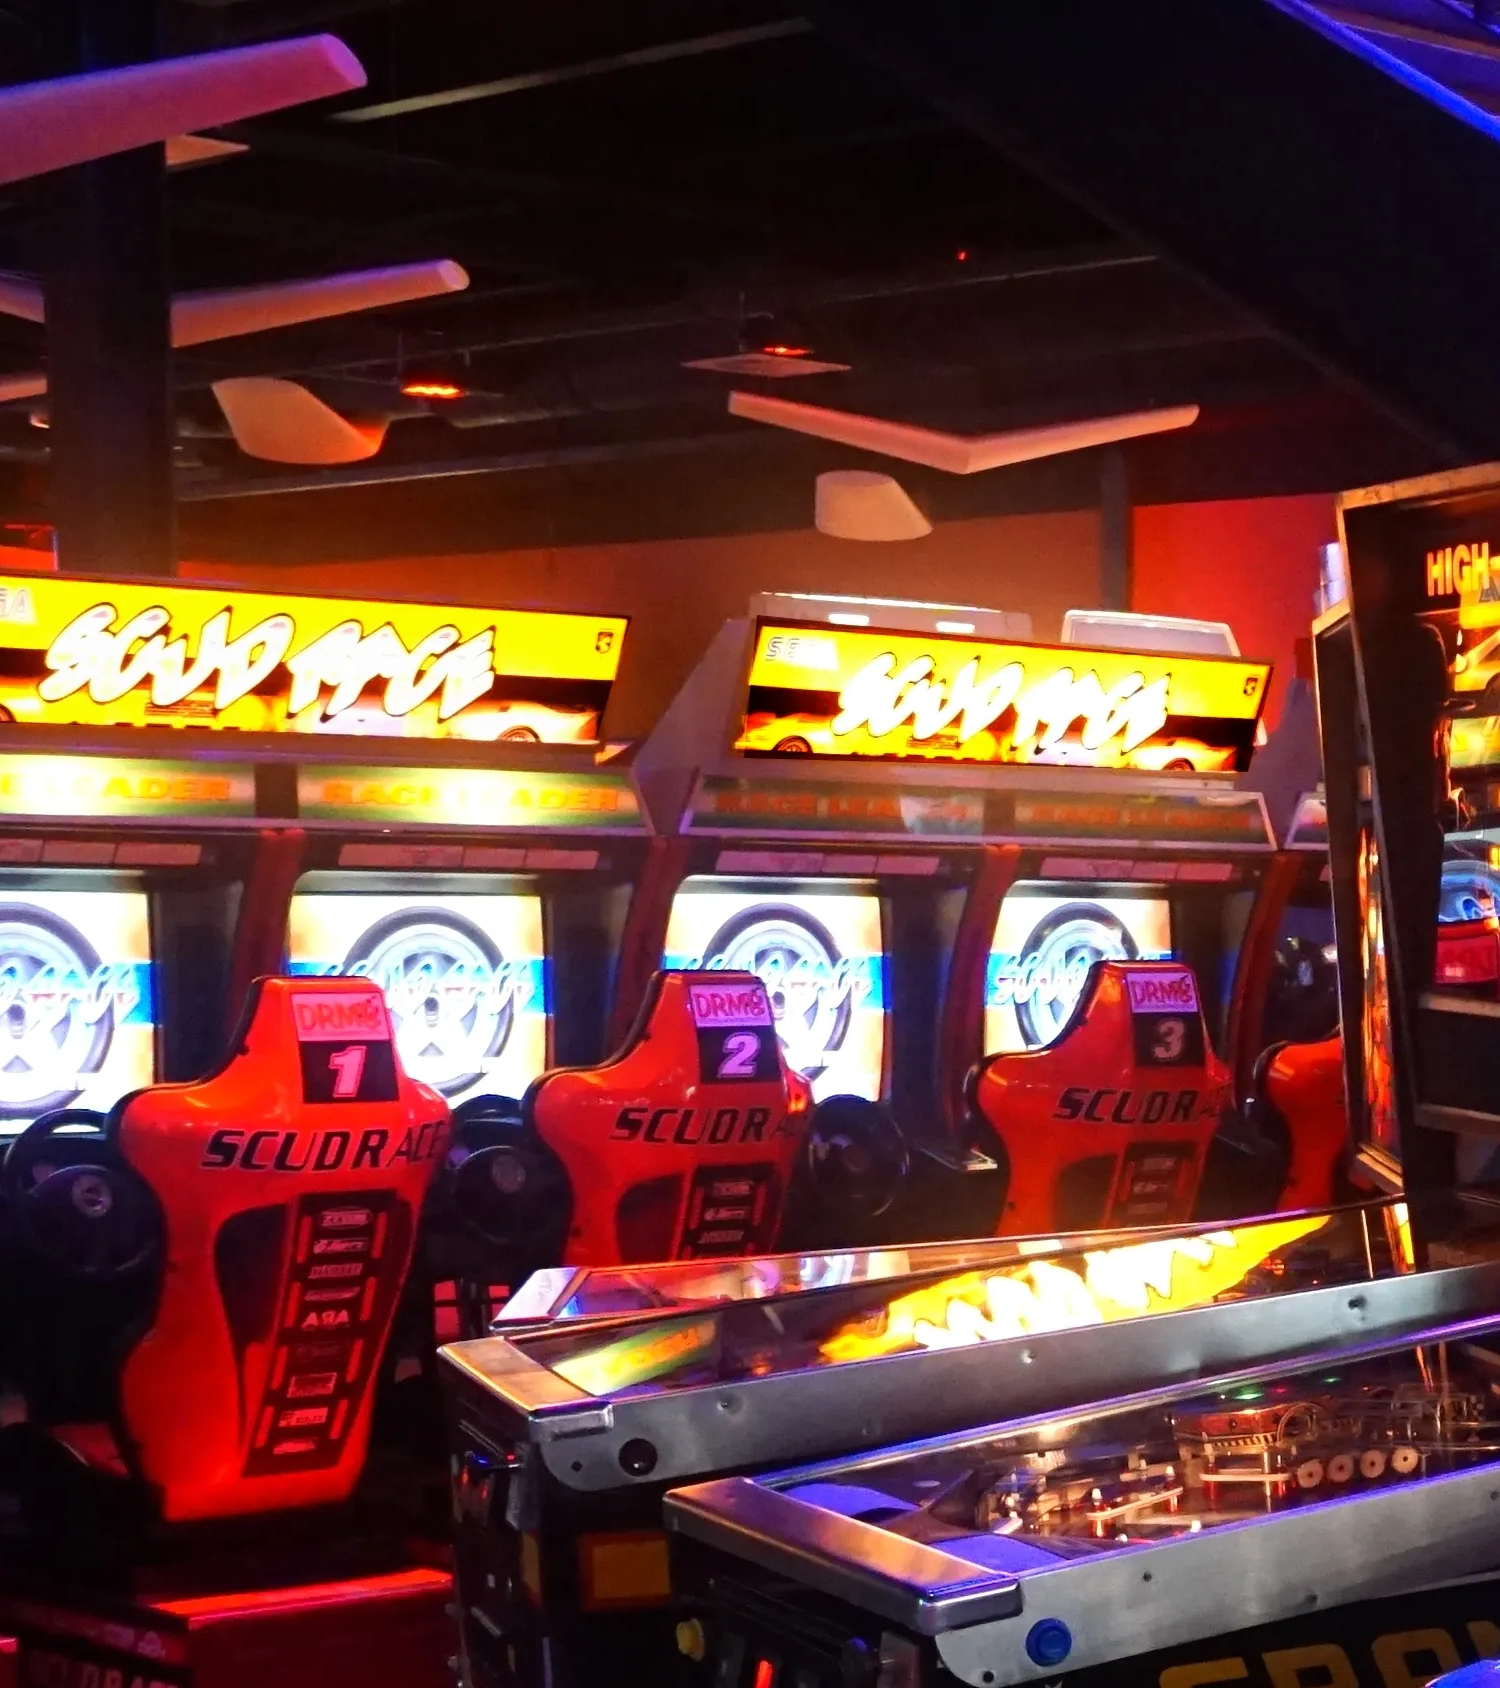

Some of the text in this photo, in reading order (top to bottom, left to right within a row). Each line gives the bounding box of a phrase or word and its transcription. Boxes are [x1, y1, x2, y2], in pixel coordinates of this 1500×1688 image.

[36, 602, 498, 724] SCUD RACE
[764, 635, 836, 667] SE
[829, 650, 1028, 748] SCUD
[717, 1031, 762, 1079] 2
[1152, 1018, 1187, 1062] 3
[328, 1045, 368, 1098] 1
